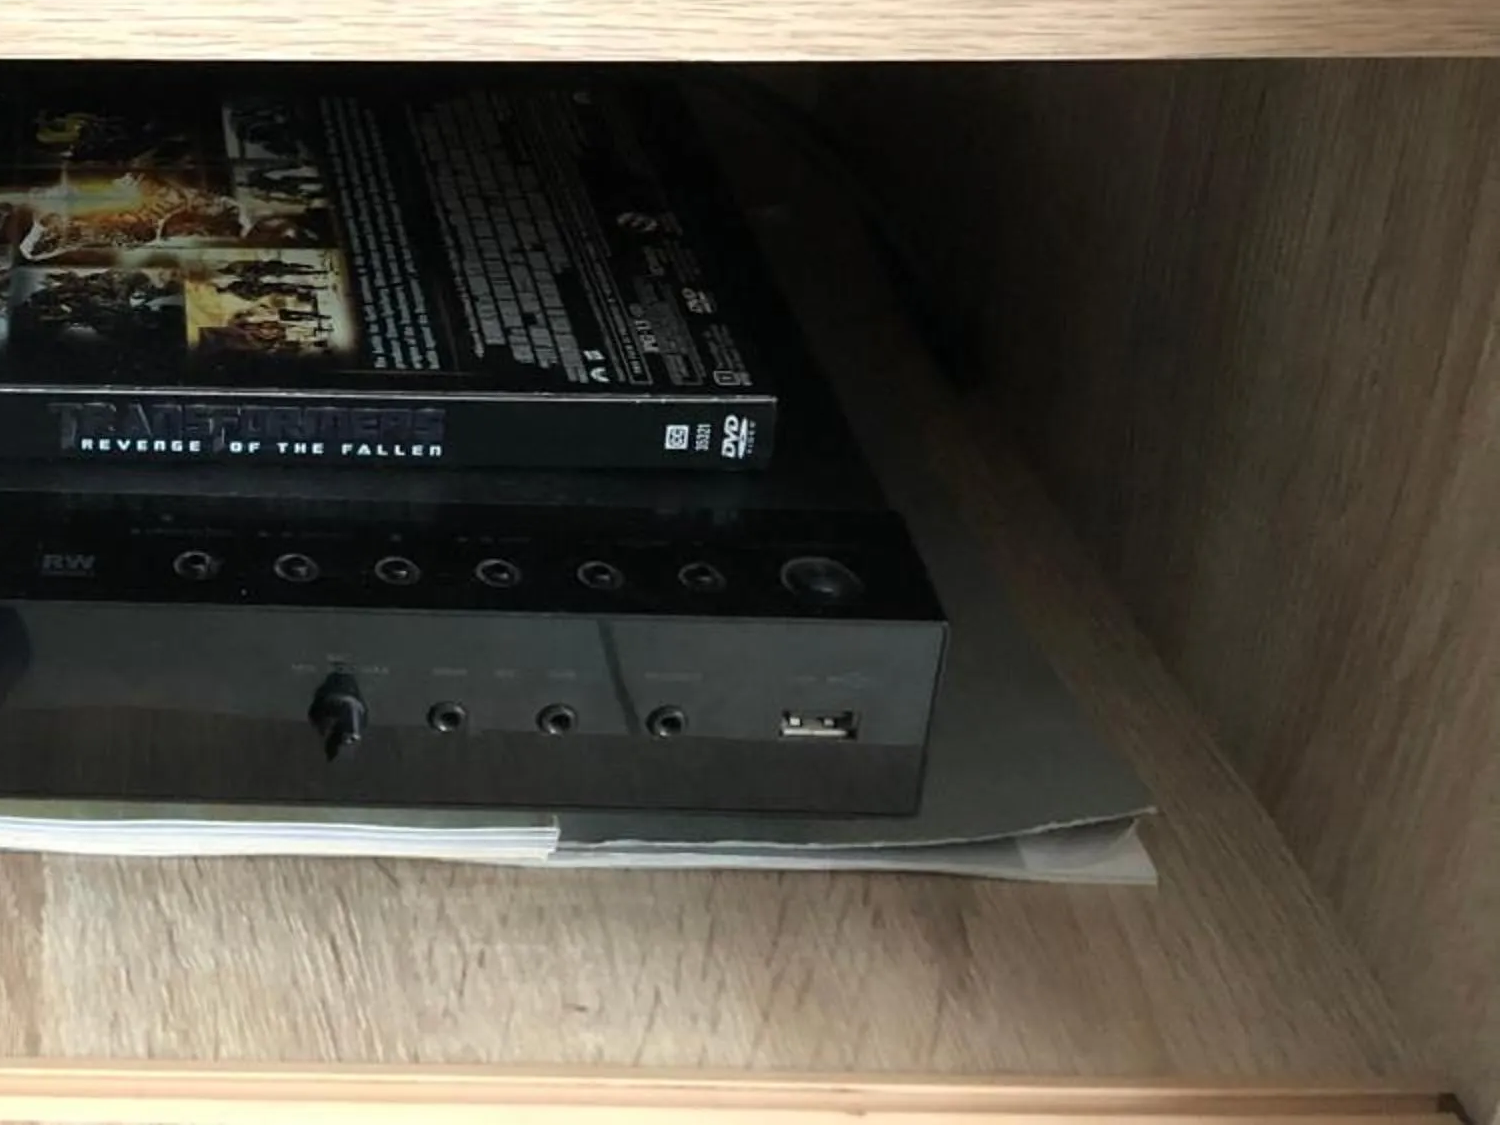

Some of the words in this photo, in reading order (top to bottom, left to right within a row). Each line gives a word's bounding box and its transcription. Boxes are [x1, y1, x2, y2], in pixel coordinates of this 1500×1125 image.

[721, 414, 741, 459] DVD
[229, 440, 262, 455] OF
[276, 441, 326, 456] THE
[42, 554, 97, 570] RW
